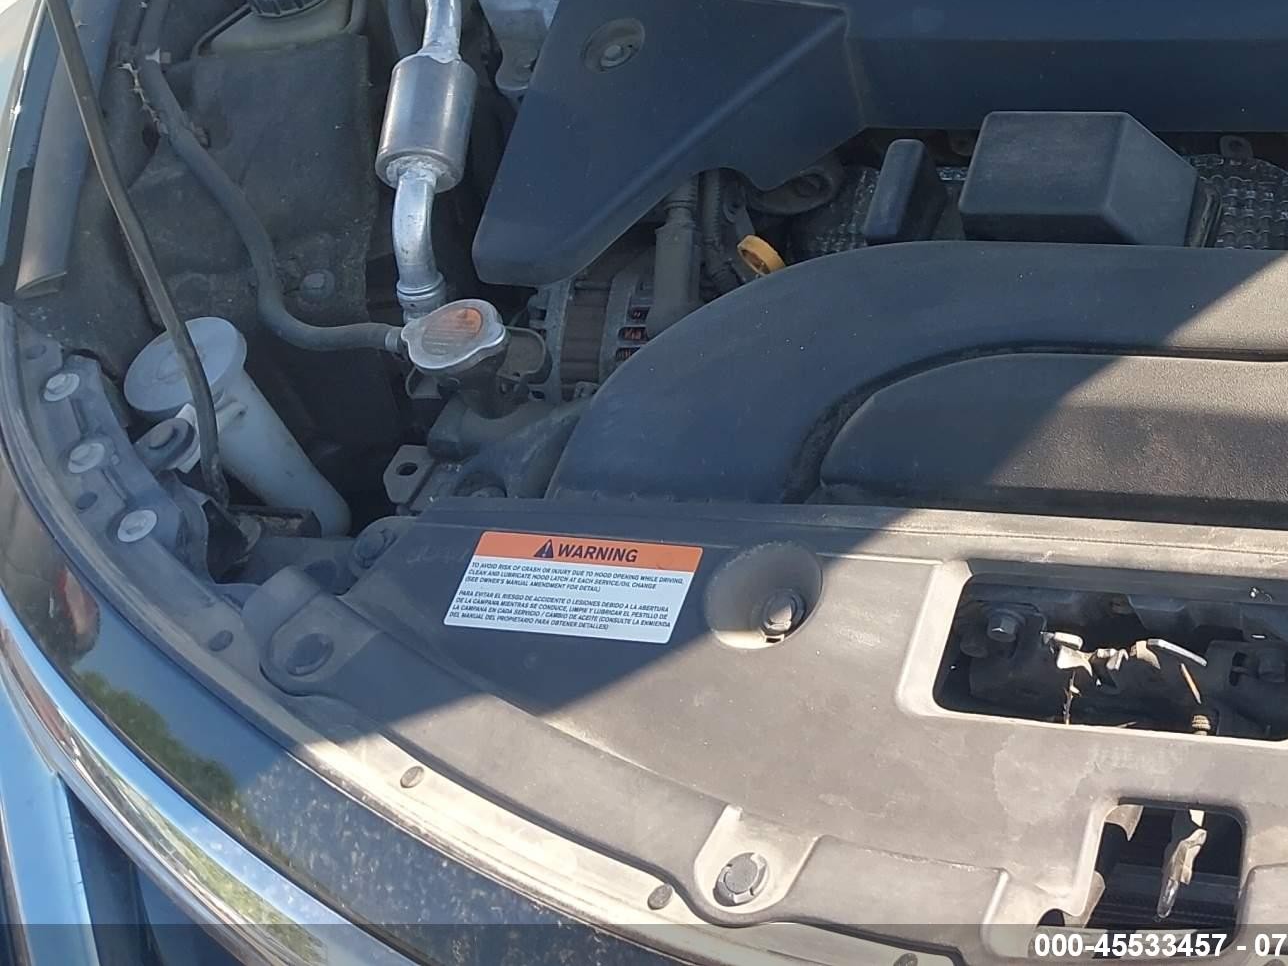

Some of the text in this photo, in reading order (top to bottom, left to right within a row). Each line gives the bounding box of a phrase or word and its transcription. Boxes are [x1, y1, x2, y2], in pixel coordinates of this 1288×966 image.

[558, 544, 638, 563] WARNING
[594, 579, 631, 587] SERVICE/OIL
[500, 600, 528, 608] MIENTRAS
[594, 608, 622, 616] LUBRICAR
[534, 596, 565, 604] ACCIDENTE
[638, 604, 668, 612] ABERTURA
[462, 612, 483, 620] MANUAL
[497, 615, 534, 624] PROPIETARIO
[578, 622, 609, 630] DETALLES)
